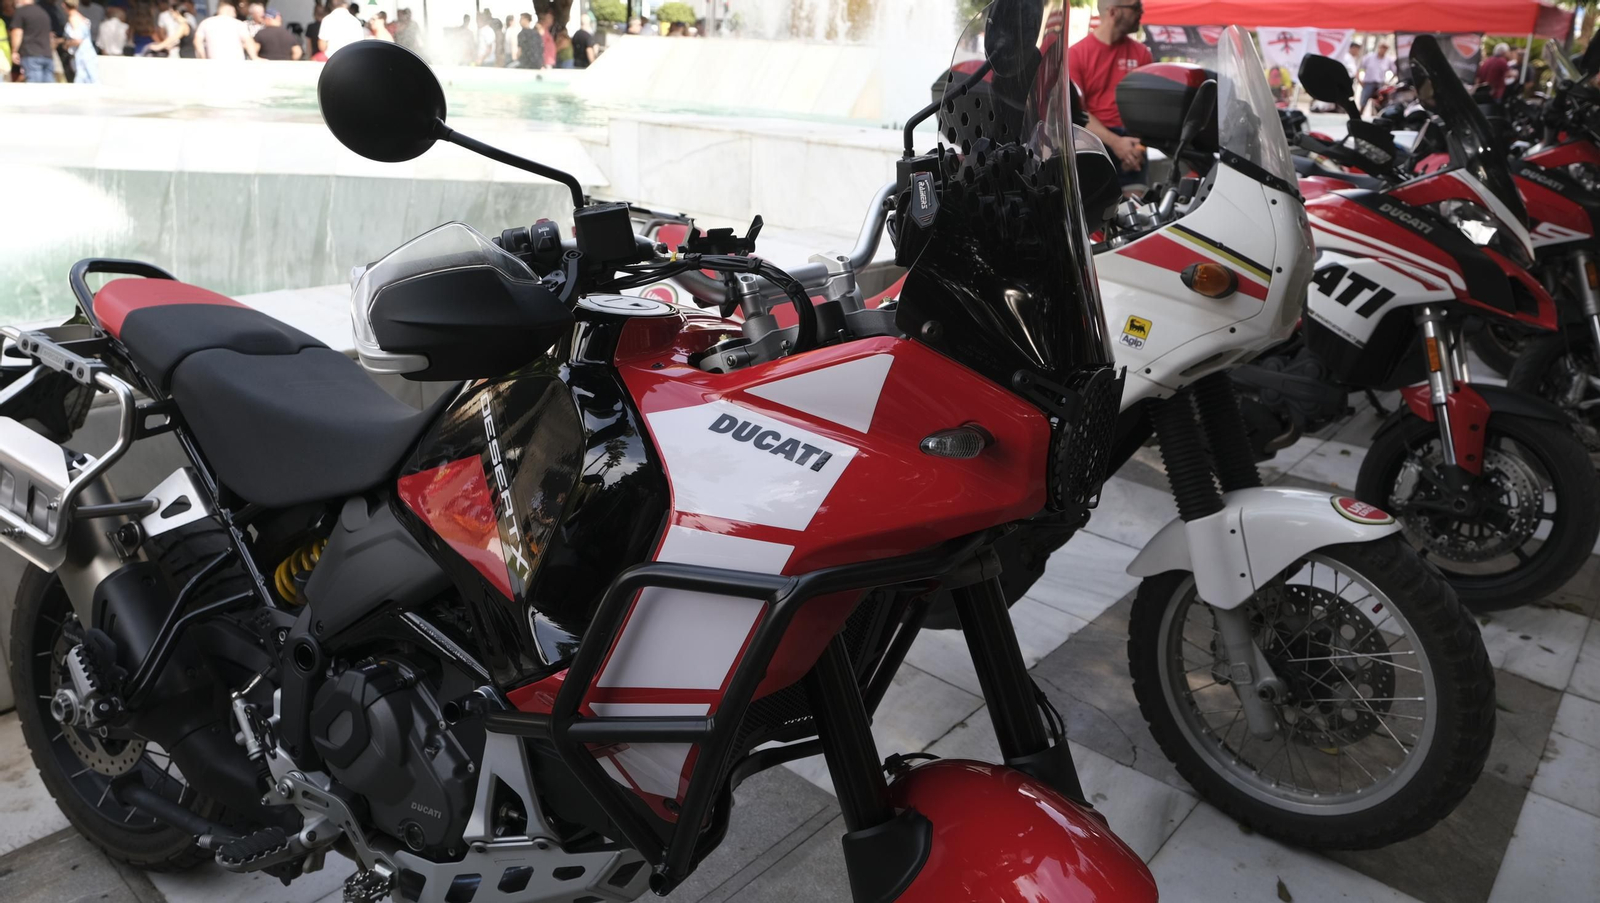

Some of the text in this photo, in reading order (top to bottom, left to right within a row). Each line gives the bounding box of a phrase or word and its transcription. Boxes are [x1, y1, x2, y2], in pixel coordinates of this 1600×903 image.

[1519, 168, 1565, 191] DUCATI
[1378, 203, 1434, 234] DUCATI
[1122, 334, 1143, 348] Agip
[708, 413, 833, 472] DUCATI
[411, 801, 442, 819] DUCATI
